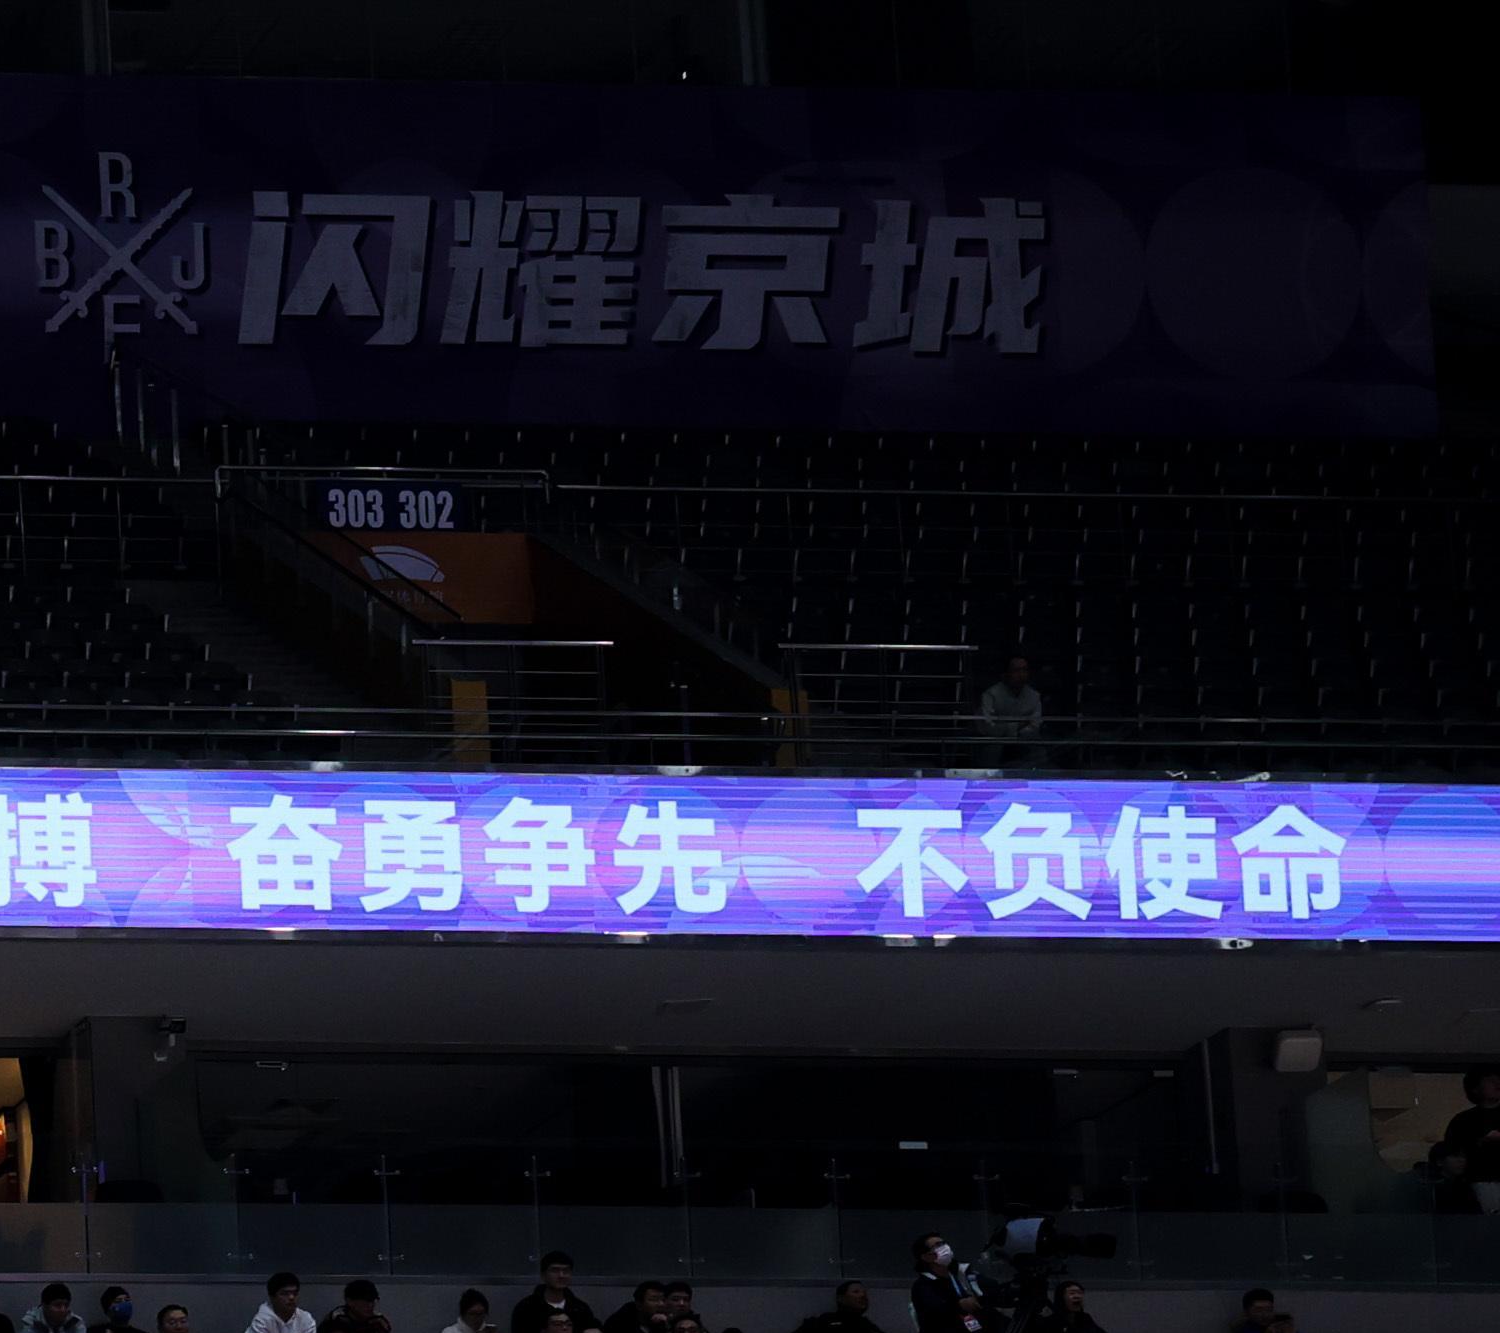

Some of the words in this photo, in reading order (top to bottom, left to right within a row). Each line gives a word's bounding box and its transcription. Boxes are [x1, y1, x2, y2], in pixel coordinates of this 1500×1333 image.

[236, 189, 1049, 358] 闪耀京城
[328, 488, 385, 528] 303
[398, 489, 455, 529] 302
[226, 793, 731, 918] 奋勇争先
[854, 802, 1349, 921] 不负使命
